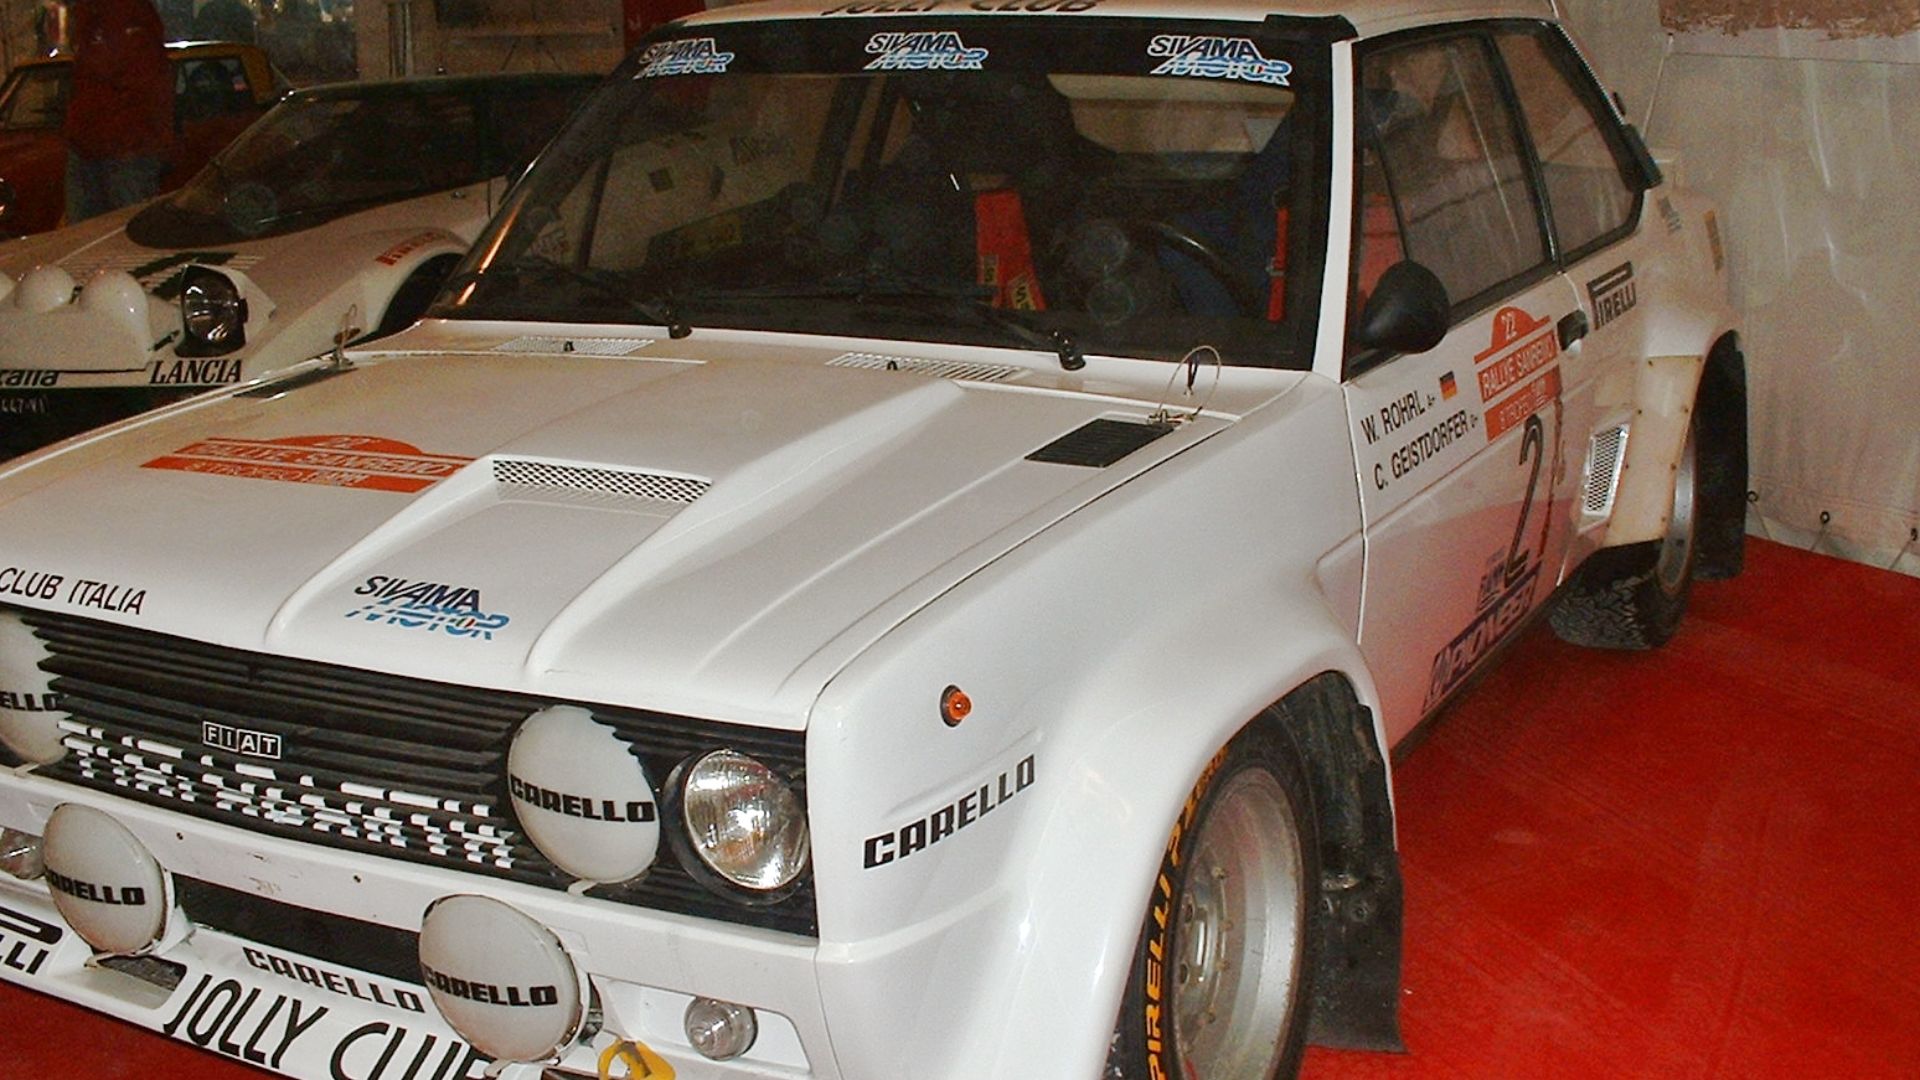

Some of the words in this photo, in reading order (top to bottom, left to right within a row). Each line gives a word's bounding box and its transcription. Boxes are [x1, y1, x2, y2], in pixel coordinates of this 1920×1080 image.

[863, 49, 989, 70] MOTOR
[865, 32, 963, 53] SIVAMA
[1148, 35, 1263, 60] SIVAMA
[1150, 58, 1293, 86] MOTOR
[1586, 260, 1637, 331] PIRELLI
[150, 359, 243, 385] LANCIA
[1361, 414, 1380, 445] W.
[1380, 389, 1426, 435] ROHRL
[1373, 463, 1389, 491] C.
[1390, 409, 1469, 480] GEISTDORFER
[0, 567, 63, 602] CLUB
[68, 580, 147, 616] ITALIA
[354, 574, 482, 614] SIVAMA
[344, 598, 510, 642] MOTOR
[203, 720, 282, 760] FIAT
[510, 775, 656, 823] CARELLO
[863, 753, 1036, 869] CARELLO
[46, 868, 146, 906] ARELLO
[242, 946, 426, 1014] CARELLO
[422, 965, 558, 1007] CARELLO
[1145, 873, 1173, 1080] PIRELLI
[163, 972, 329, 1070] JOLLY
